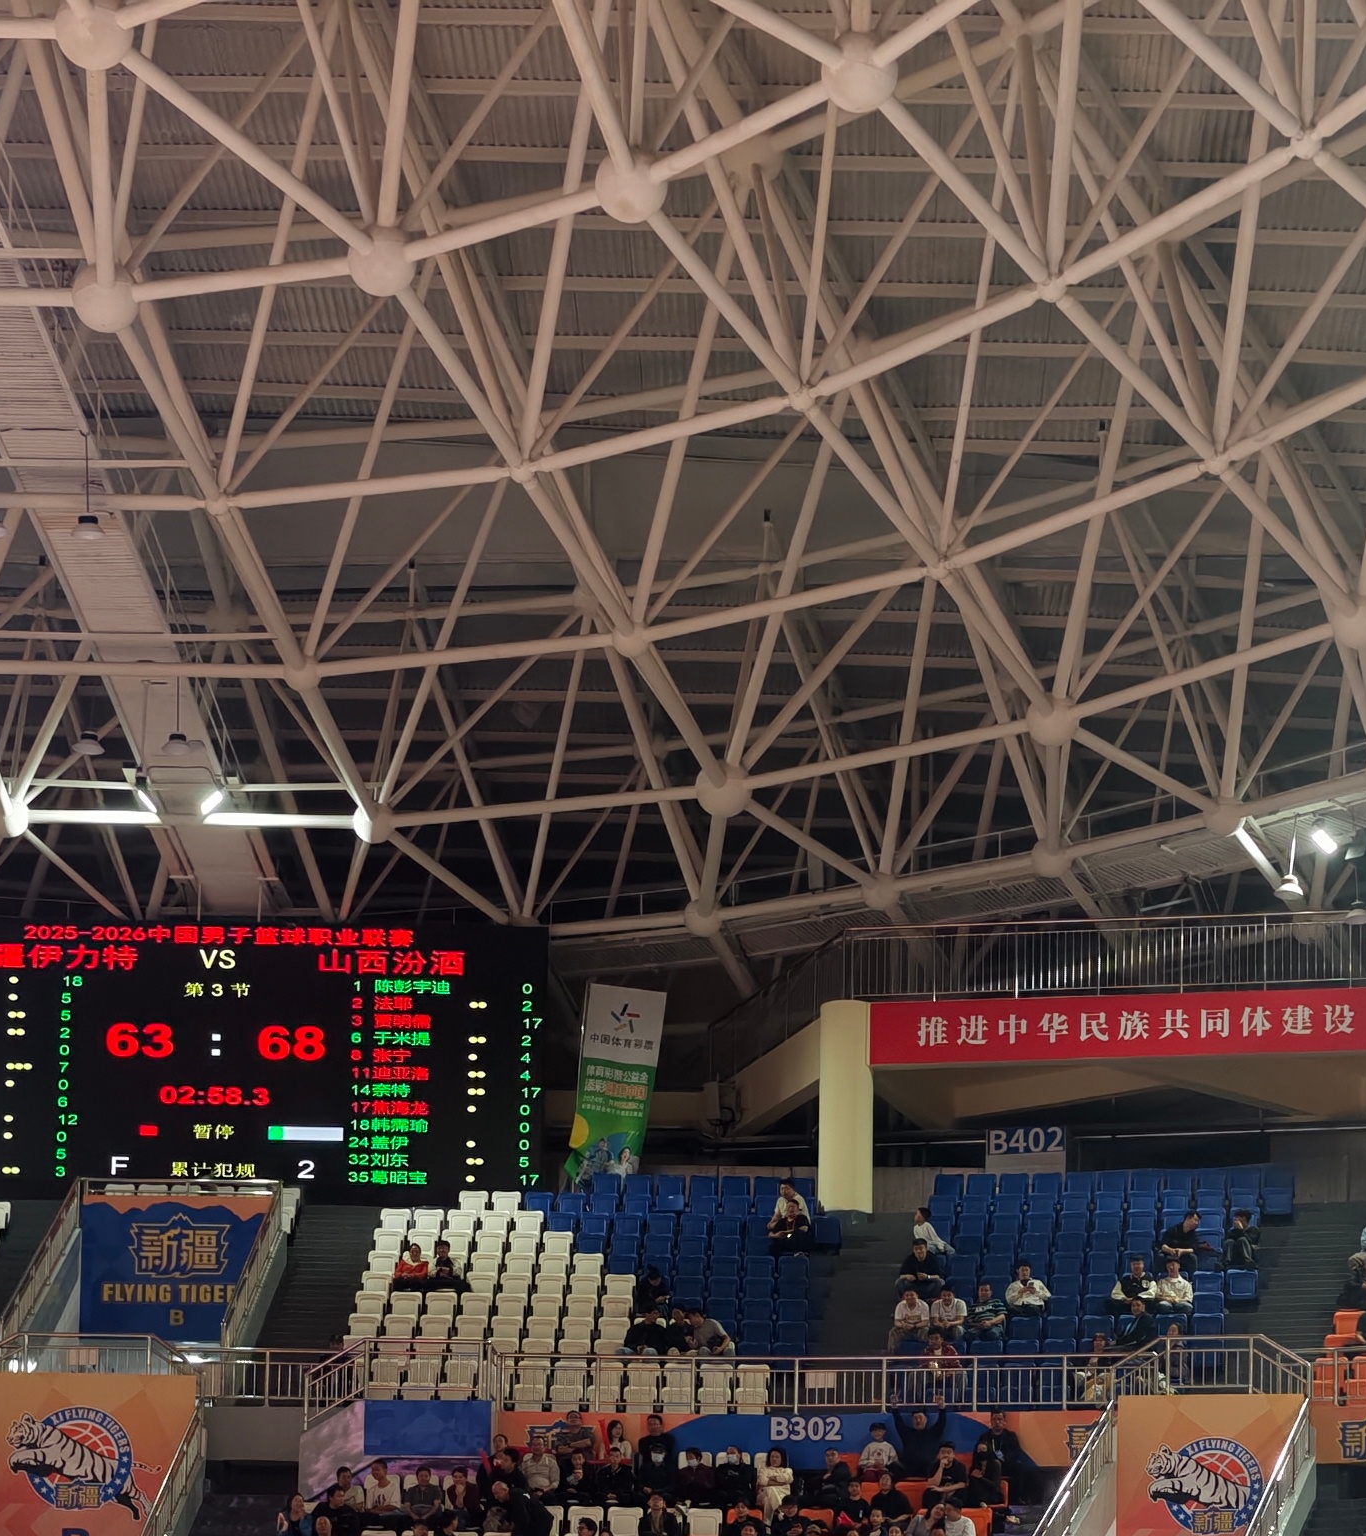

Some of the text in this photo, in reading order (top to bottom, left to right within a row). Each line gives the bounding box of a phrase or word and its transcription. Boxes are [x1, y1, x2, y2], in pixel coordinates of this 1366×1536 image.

[200, 949, 236, 969] VS
[318, 948, 465, 976] 山西汾酒
[63, 976, 82, 986] 18
[354, 981, 360, 991] 1
[522, 984, 532, 994] 0
[184, 981, 250, 998] 第 3 节
[61, 993, 71, 1003] 5
[351, 998, 363, 1009] 2
[522, 1001, 532, 1012] 2
[61, 1010, 71, 1021] 5
[351, 1015, 362, 1026] 3
[523, 1019, 542, 1029] 17
[917, 1004, 1357, 1047] 推进中华民族共同体建设
[60, 1028, 70, 1038] 2
[351, 1032, 531, 1046] 6 于米提 2
[106, 1022, 174, 1057] 63
[257, 1025, 325, 1061] 68
[590, 1033, 654, 1051] 中国体育彩票
[60, 1045, 69, 1055] 0
[351, 1049, 531, 1063] 8 张宁 4
[59, 1063, 69, 1073] 7
[520, 1070, 530, 1081] 4
[58, 1080, 68, 1090] 0
[159, 1084, 270, 1107] 02:58.3
[522, 1088, 541, 1098] 17
[58, 1097, 68, 1107] 6
[520, 1105, 530, 1115] 0
[59, 1115, 77, 1125] 12
[519, 1122, 530, 1132] 0
[57, 1132, 67, 1142] 0
[192, 1124, 235, 1140] 暂停
[519, 1140, 529, 1150] 0
[988, 1126, 1064, 1156] B402
[57, 1149, 66, 1159] 5
[110, 1156, 315, 1179] F 累计犯规 2
[519, 1157, 529, 1168] 5
[56, 1166, 65, 1177] 3
[520, 1175, 539, 1185] 17
[139, 1229, 219, 1272] 新疆
[102, 1284, 172, 1304] FLYING
[169, 1309, 184, 1326] B
[65, 1408, 103, 1423] FLYING
[101, 1414, 131, 1454] TIGERS
[770, 1415, 842, 1443] B302
[1198, 1439, 1235, 1453] FLYING
[1233, 1446, 1261, 1481] TIGERS
[56, 1484, 101, 1509] 新疆
[1193, 1510, 1236, 1534] 新疆
